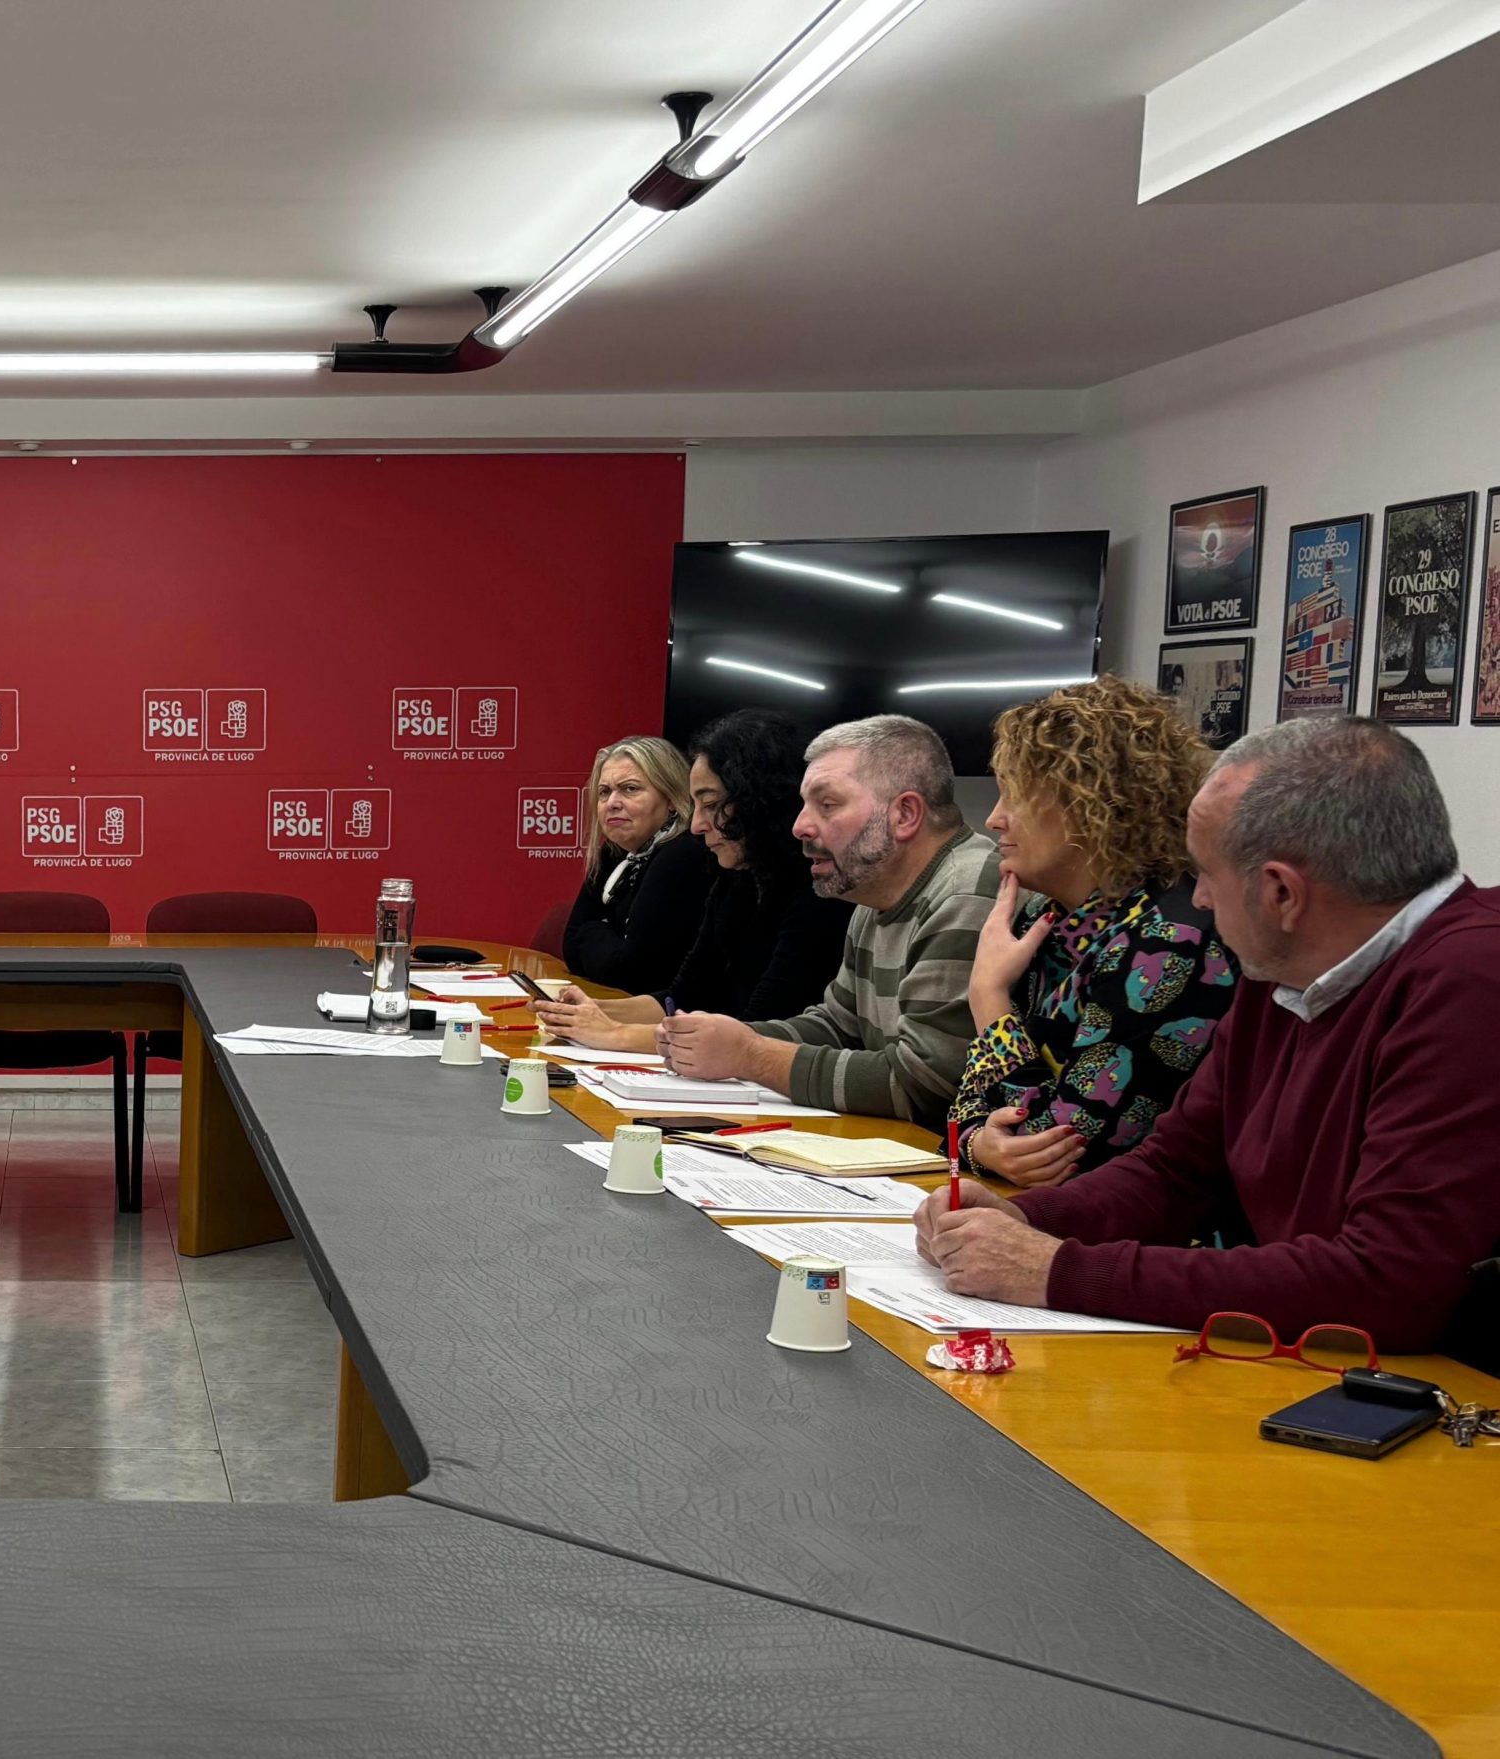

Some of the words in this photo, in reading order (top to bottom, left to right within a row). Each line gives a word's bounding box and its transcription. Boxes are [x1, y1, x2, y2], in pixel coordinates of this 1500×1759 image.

[1324, 528, 1337, 543] 28
[1297, 540, 1350, 562] CONGRESO
[1417, 549, 1432, 570] 29
[1296, 561, 1322, 579] PSOE
[1388, 568, 1460, 596] CONGRESO
[1176, 602, 1204, 623] VOTA
[1210, 598, 1242, 620] PSOE
[1404, 593, 1439, 616] PSOE
[149, 718, 199, 737] PSOE
[398, 717, 448, 736] PSOE
[155, 752, 209, 762] PROVINCIA
[212, 752, 225, 762] DE
[228, 752, 254, 762] LUGO
[404, 751, 458, 761] PROVINCIA
[462, 751, 474, 761] DE
[478, 751, 504, 761] LUGO
[27, 824, 77, 843] PSOE
[273, 818, 323, 836] PSOE
[523, 816, 573, 834] PSOE
[34, 857, 87, 868] PROVINCIA
[90, 857, 102, 868] DE
[106, 857, 132, 868] LUGO
[279, 851, 333, 861] PROVINCIA
[337, 851, 348, 861] DE
[352, 851, 378, 861] LUGO
[529, 849, 583, 859] PROVINCIA
[951, 1157, 960, 1178] PSOE
